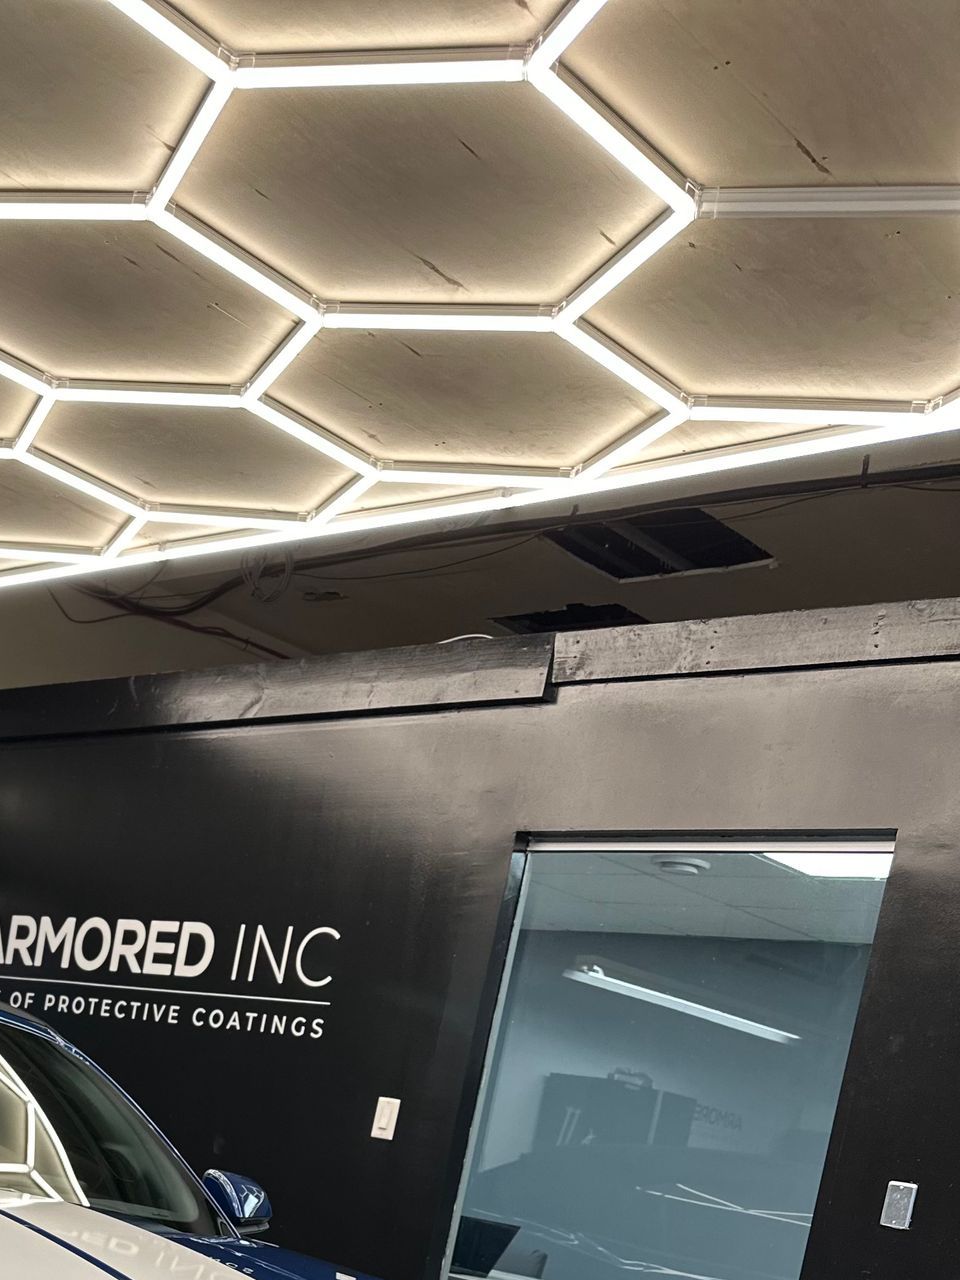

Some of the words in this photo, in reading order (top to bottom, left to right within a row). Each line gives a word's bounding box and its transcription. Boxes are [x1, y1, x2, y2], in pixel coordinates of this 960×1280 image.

[230, 923, 342, 988] INC
[9, 991, 35, 1009] OF
[43, 993, 181, 1025] PROTECTIVE
[191, 1007, 325, 1039] COATINGS
